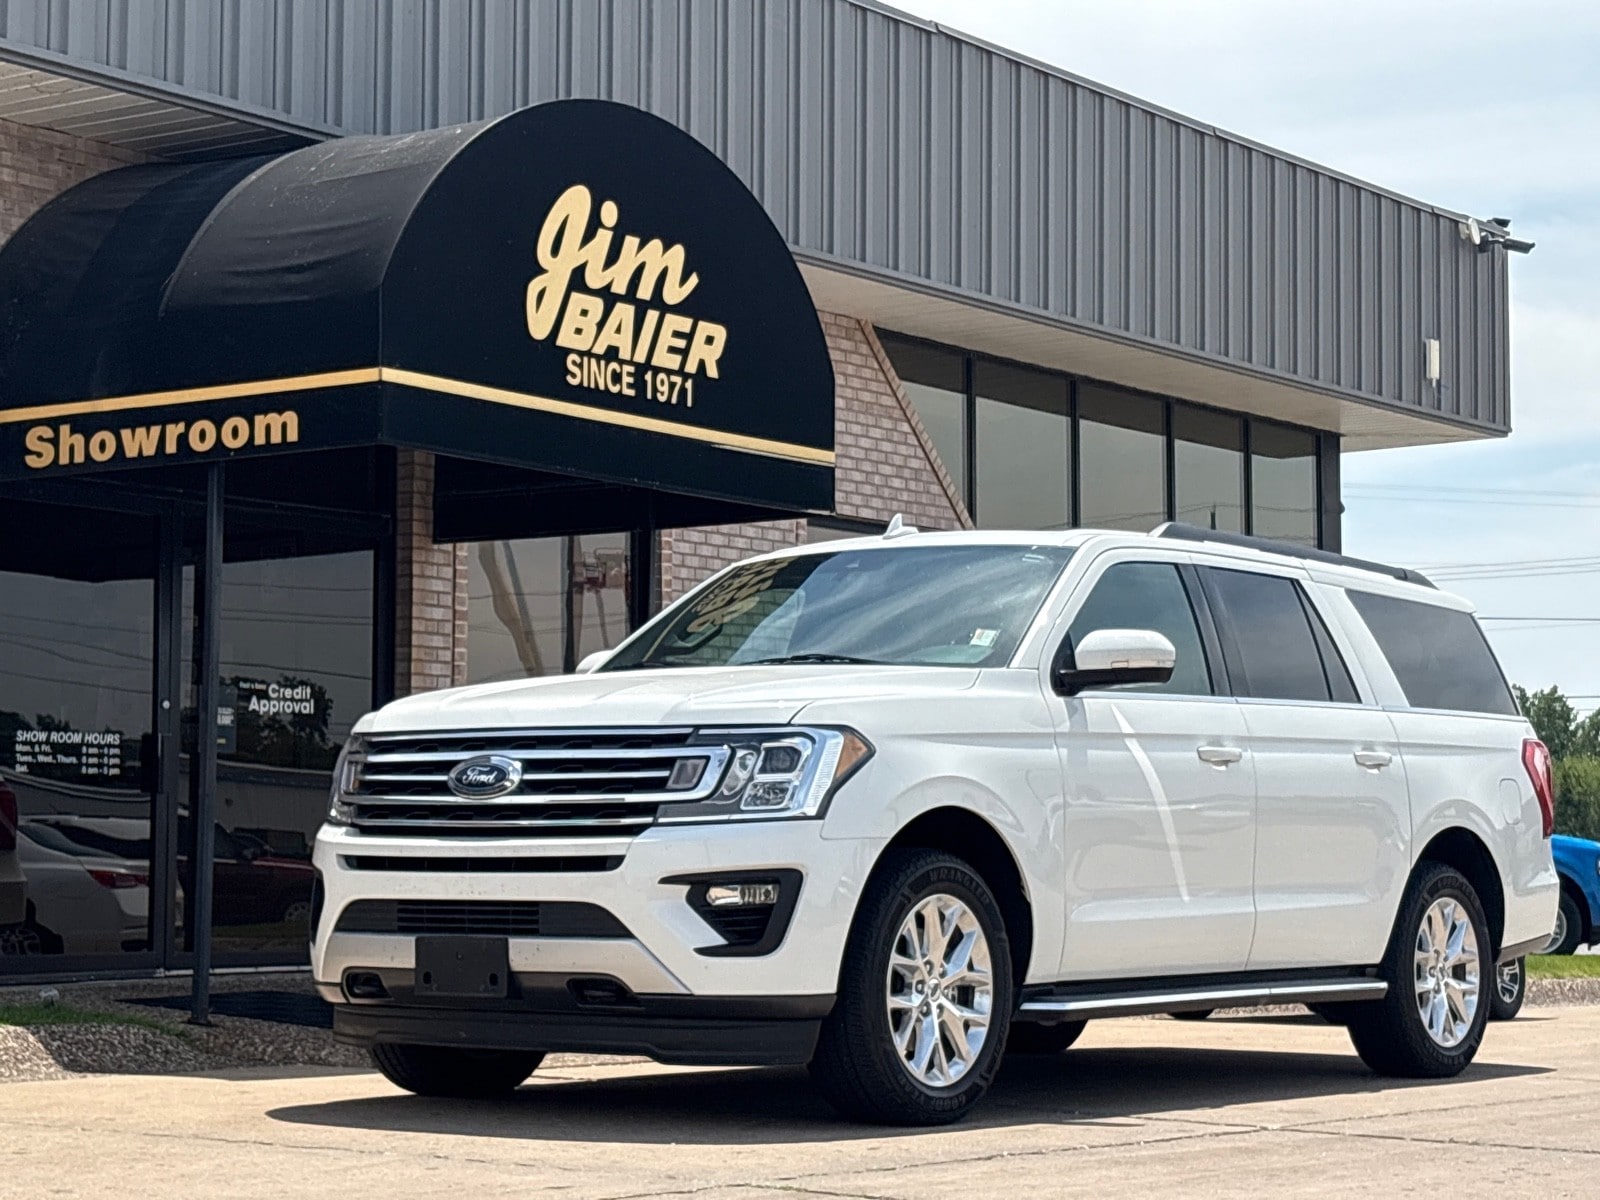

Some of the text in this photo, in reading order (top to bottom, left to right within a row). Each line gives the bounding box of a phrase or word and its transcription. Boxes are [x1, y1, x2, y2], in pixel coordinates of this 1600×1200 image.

[526, 185, 699, 341] Jim
[555, 291, 727, 379] BAIER
[566, 353, 693, 407] SINCE 1971
[24, 410, 299, 469] Showroom
[248, 695, 314, 715] Approval
[268, 683, 311, 699] Credit
[16, 729, 120, 745] SHOW ROOM HOURS
[462, 766, 498, 785] Ford
